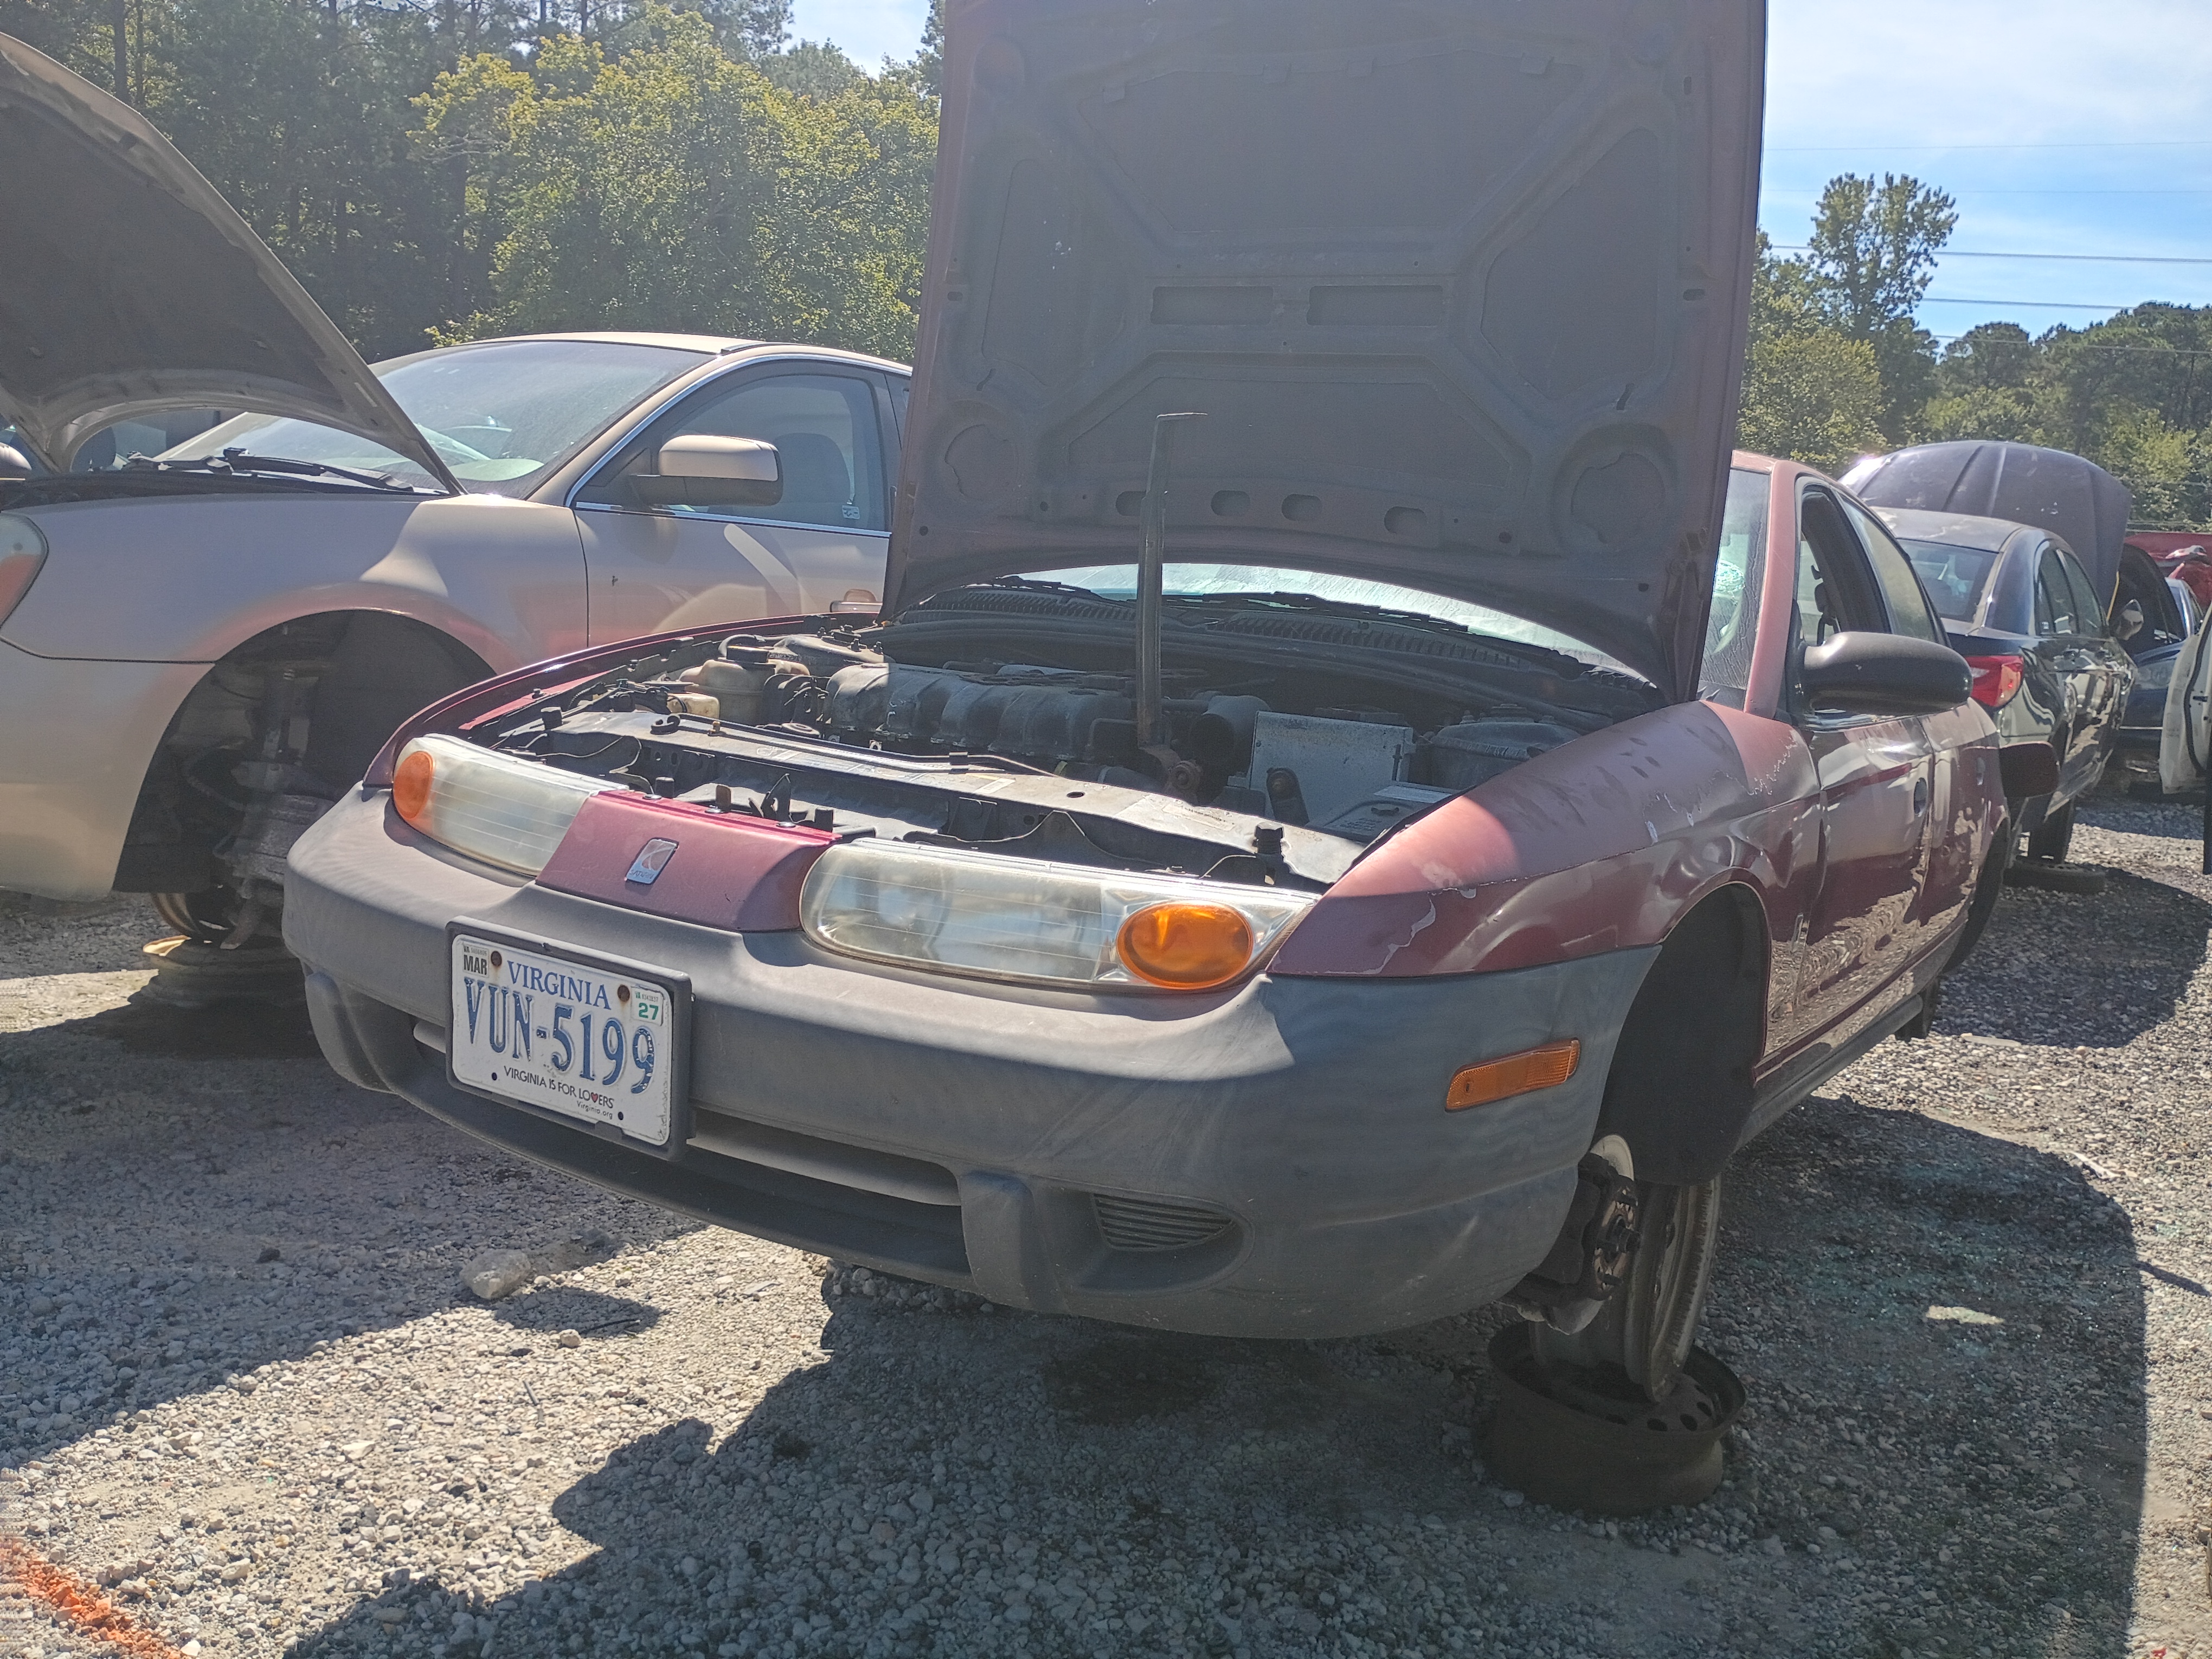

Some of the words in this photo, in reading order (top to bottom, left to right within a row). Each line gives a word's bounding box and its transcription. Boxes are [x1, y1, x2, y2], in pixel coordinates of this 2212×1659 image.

[464, 954, 487, 975] MAR
[507, 961, 611, 1010] VIRGINIA
[639, 1002, 658, 1020] 27
[464, 978, 655, 1094] VUN-5199
[504, 1065, 546, 1088] VIRGINIA
[549, 1079, 556, 1090] IS
[558, 1082, 576, 1097] FOR
